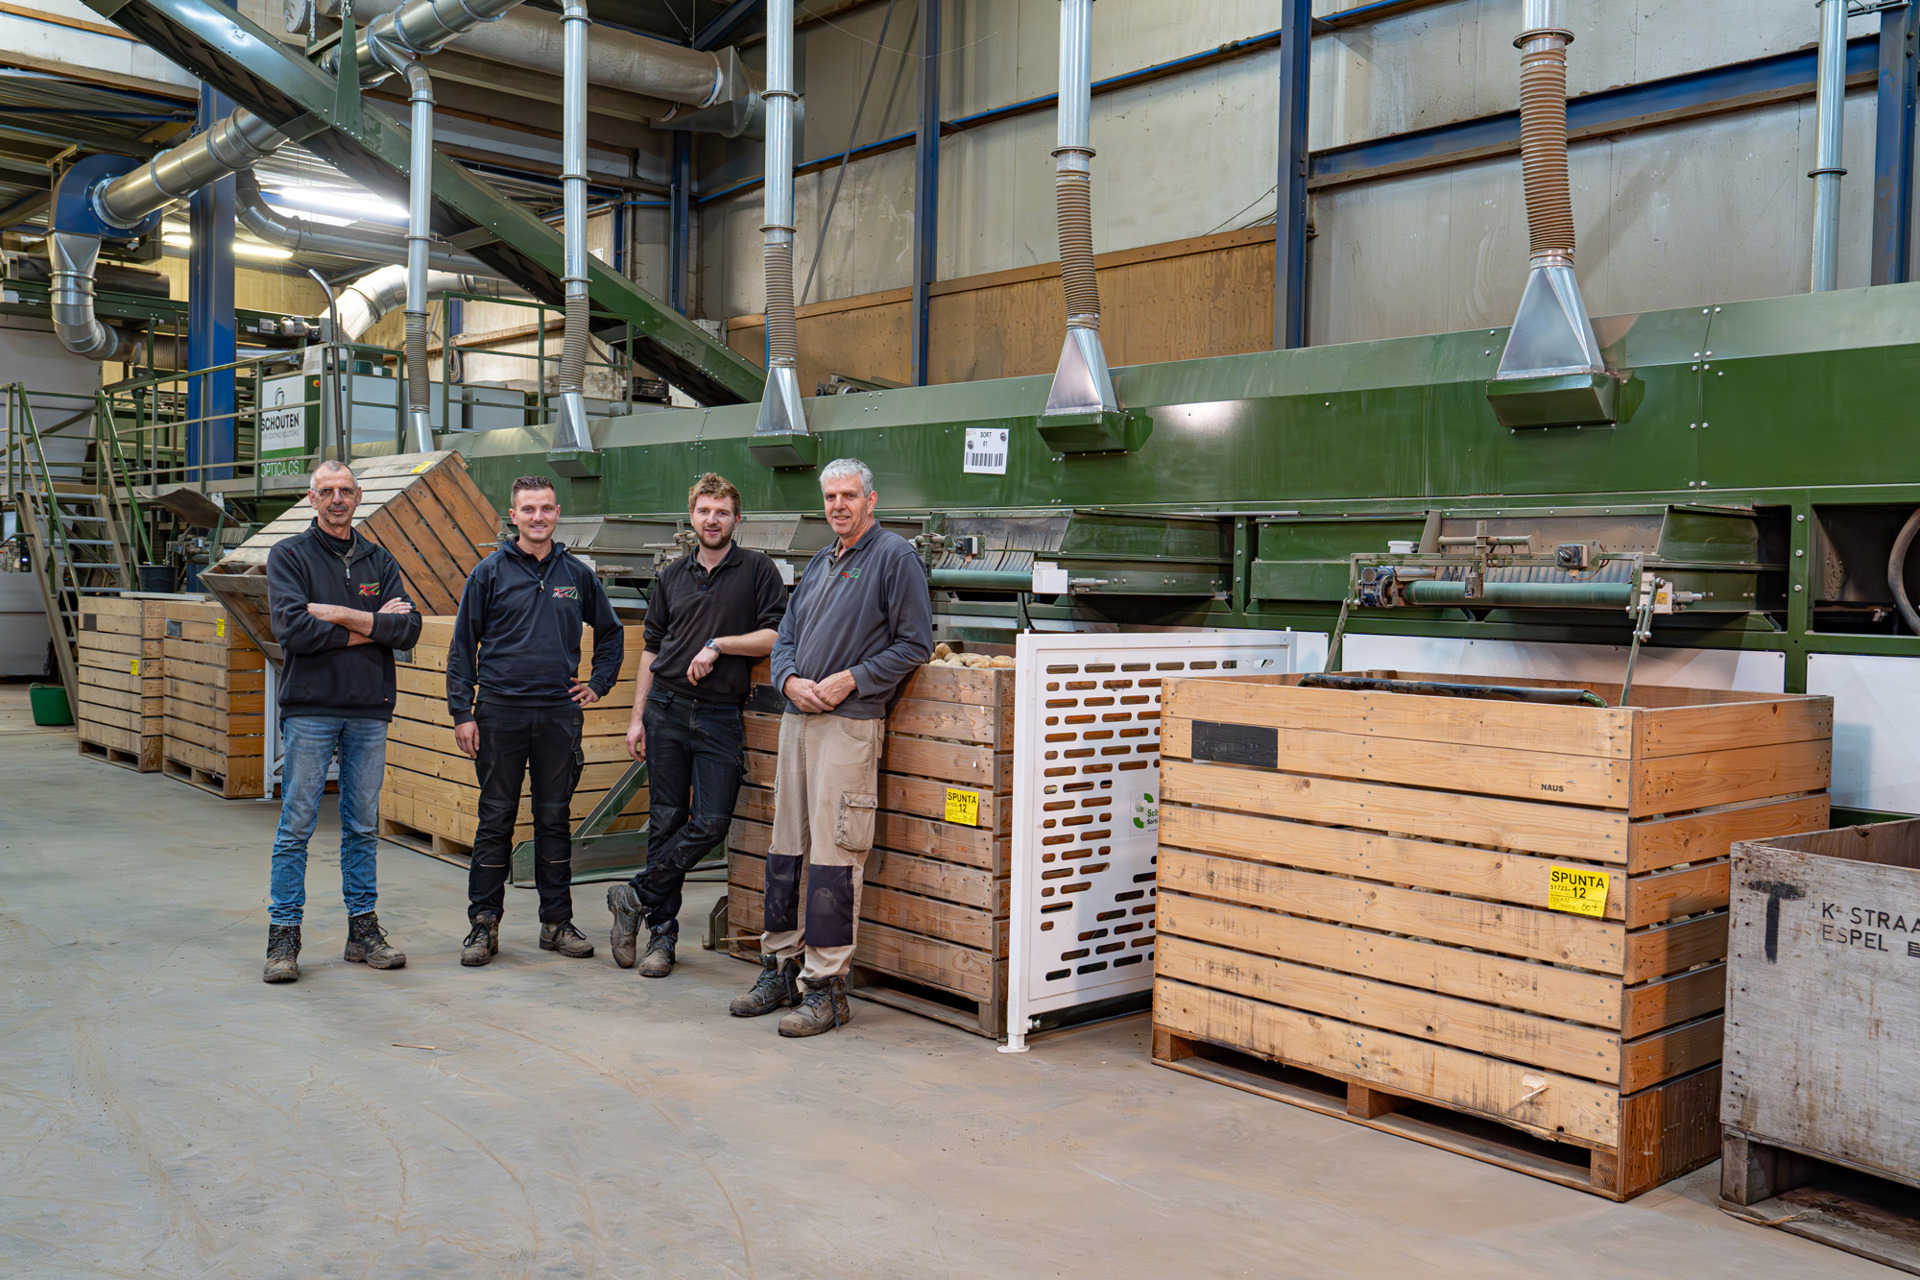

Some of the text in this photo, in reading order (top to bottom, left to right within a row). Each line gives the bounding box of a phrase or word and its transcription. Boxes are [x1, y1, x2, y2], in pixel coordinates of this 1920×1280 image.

[261, 413, 299, 431] SCHOUTEN
[261, 461, 299, 477] OPTICA CS
[1541, 783, 1564, 792] NAUS
[947, 792, 977, 804] SPUNTA
[1551, 870, 1604, 889] SPUNTA
[1822, 924, 1889, 952] ESPEL
